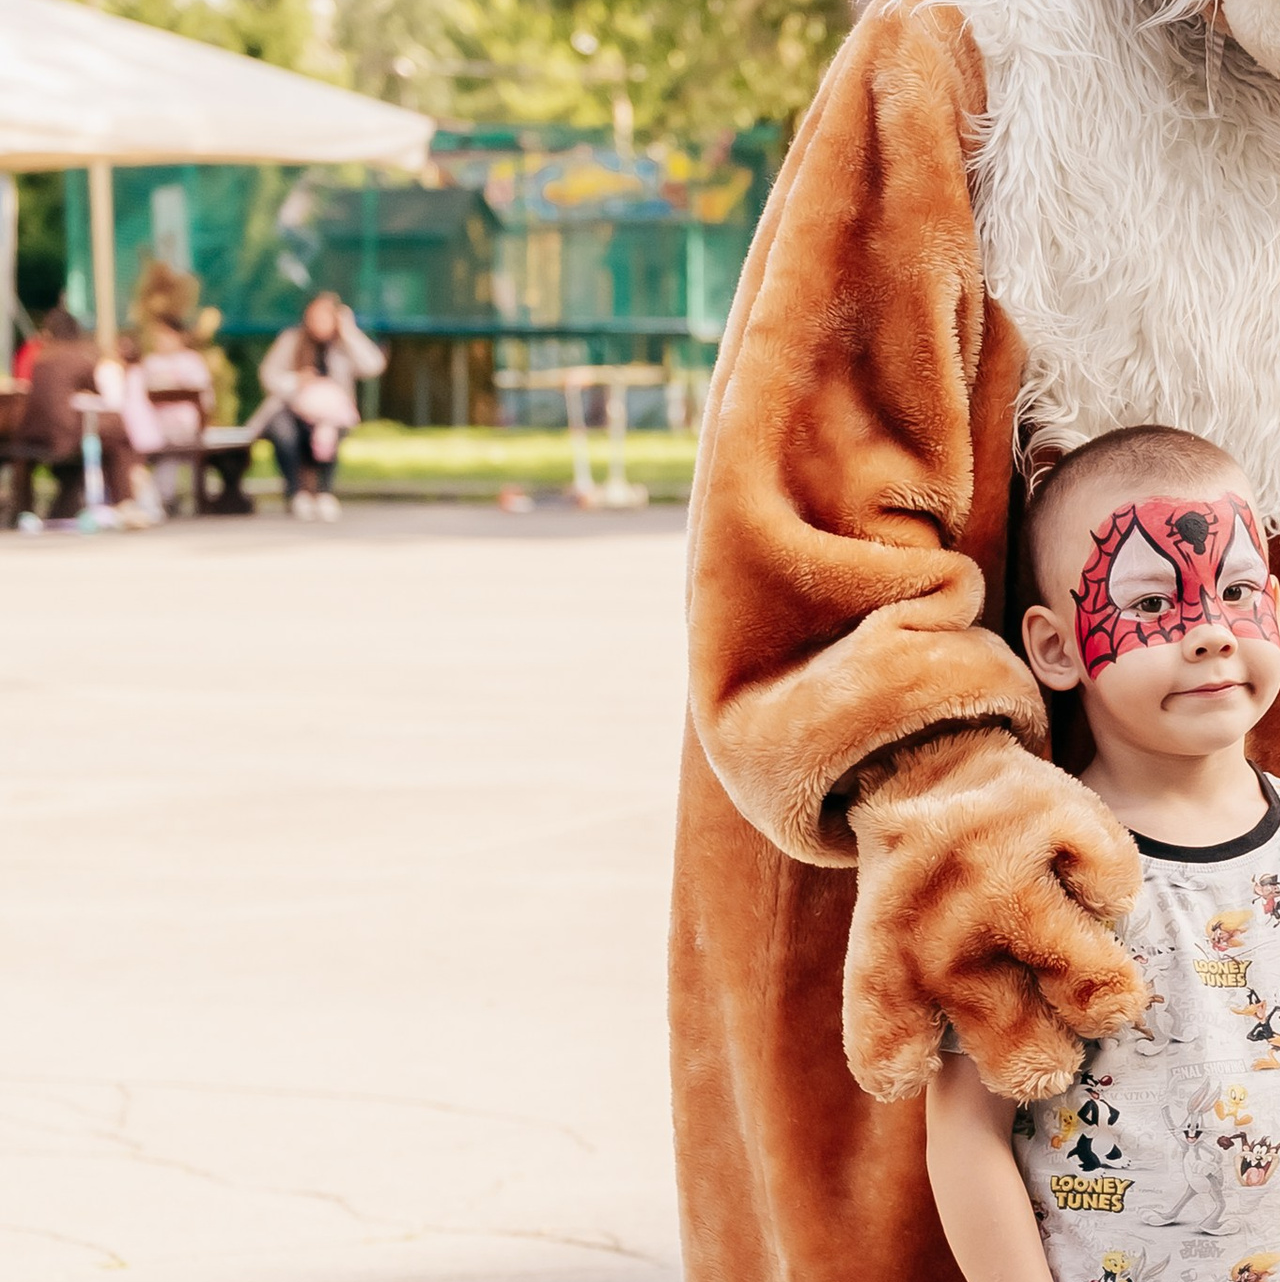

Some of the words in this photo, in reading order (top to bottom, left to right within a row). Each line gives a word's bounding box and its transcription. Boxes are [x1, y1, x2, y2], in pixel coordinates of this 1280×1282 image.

[1193, 958, 1252, 975] LOONEY
[1200, 972, 1248, 988] TUNES
[1050, 1175, 1135, 1194] LOONEY
[1055, 1192, 1124, 1213] TUNES
